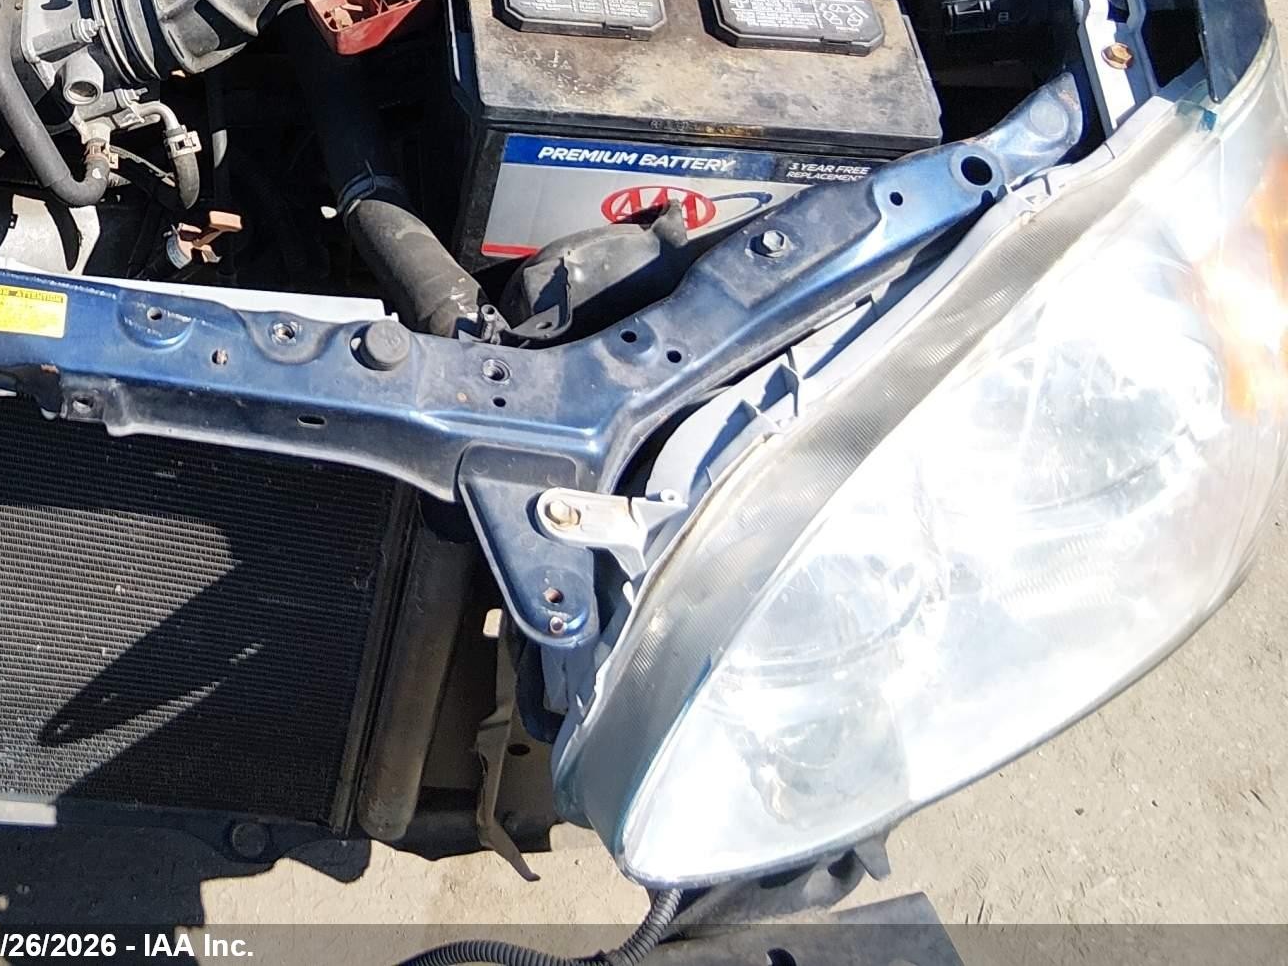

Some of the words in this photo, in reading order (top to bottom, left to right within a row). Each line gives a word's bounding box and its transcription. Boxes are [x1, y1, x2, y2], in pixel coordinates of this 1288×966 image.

[538, 146, 637, 166] PREMIUM
[639, 153, 736, 172] BATTERY
[789, 162, 800, 170] 3
[801, 163, 835, 173] YEAR
[835, 165, 871, 175] FREE
[786, 171, 865, 181] REPLACEMENT
[15, 289, 63, 304] ATTENTION
